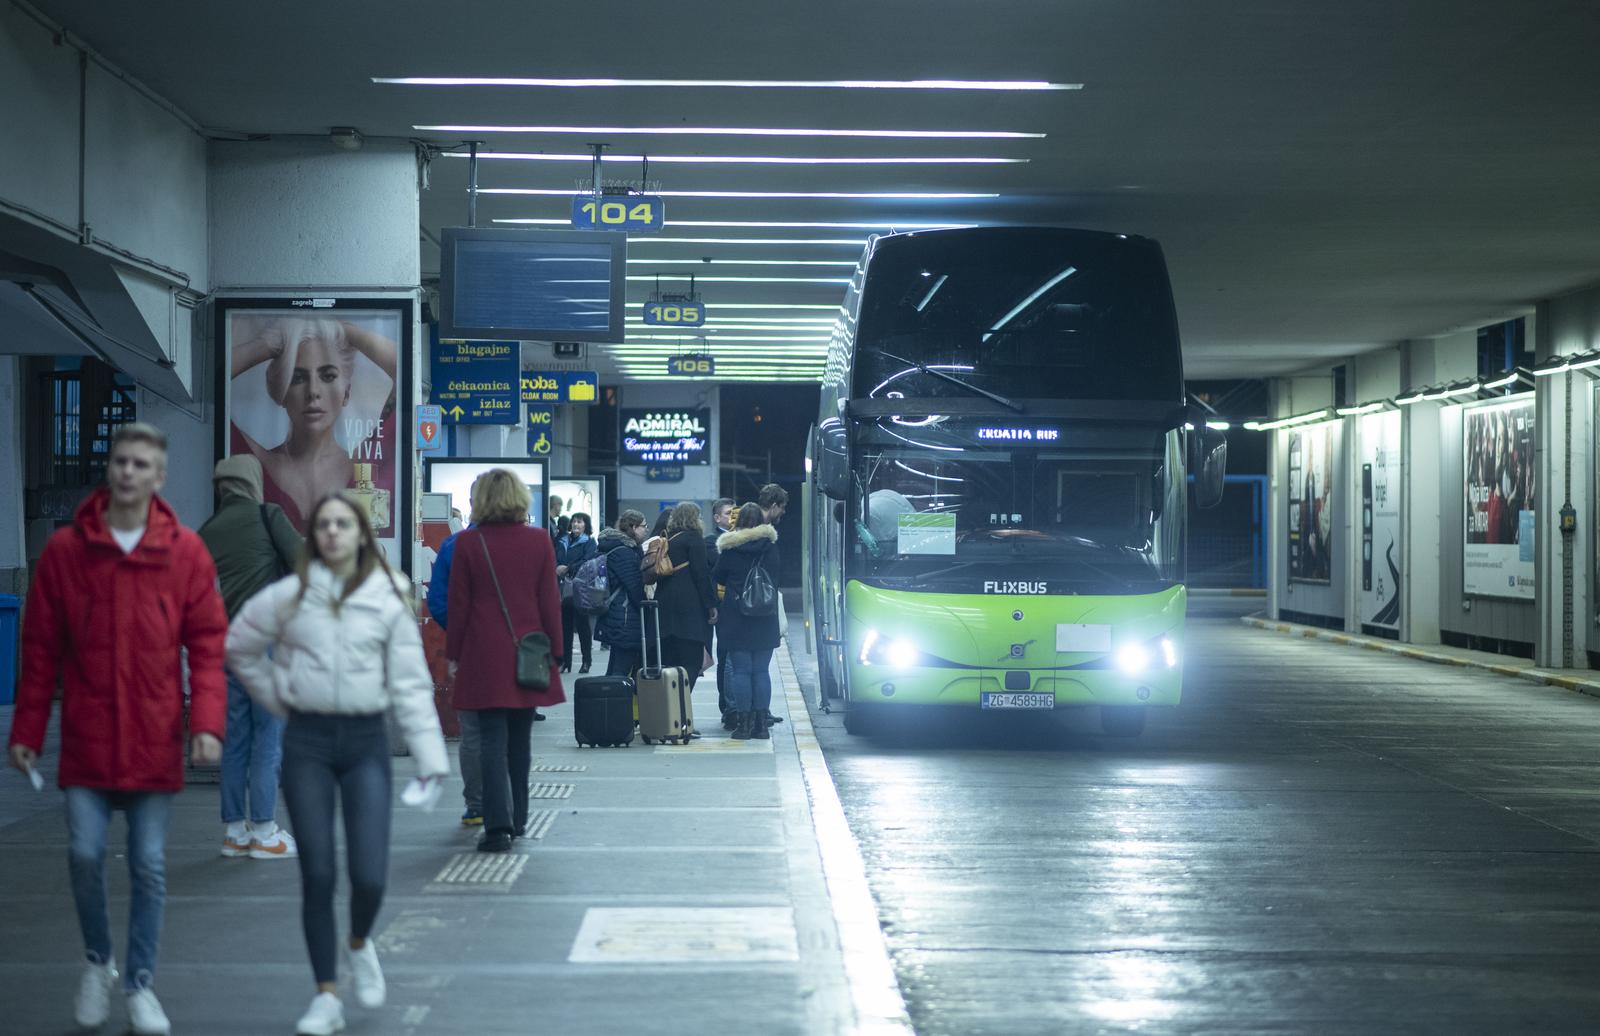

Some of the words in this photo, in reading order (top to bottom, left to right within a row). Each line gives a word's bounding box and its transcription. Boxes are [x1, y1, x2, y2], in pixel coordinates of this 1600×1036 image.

[581, 202, 654, 224] 104
[650, 306, 699, 322] 105
[457, 344, 511, 357] blagajne
[673, 360, 711, 372] 106
[448, 381, 511, 391] čekaonica
[521, 392, 540, 400] CLOAK
[542, 392, 559, 400] ROOM
[480, 399, 511, 409] izlaz
[530, 411, 551, 424] WC
[344, 419, 384, 438] VOCE
[624, 417, 706, 433] ADMIRAL
[978, 428, 1032, 440] CROATIA
[347, 441, 383, 460] VIVA
[624, 438, 652, 450] Come
[652, 441, 661, 450] in
[662, 440, 681, 450] and
[680, 438, 705, 450] Win!
[990, 694, 1004, 707] ZG
